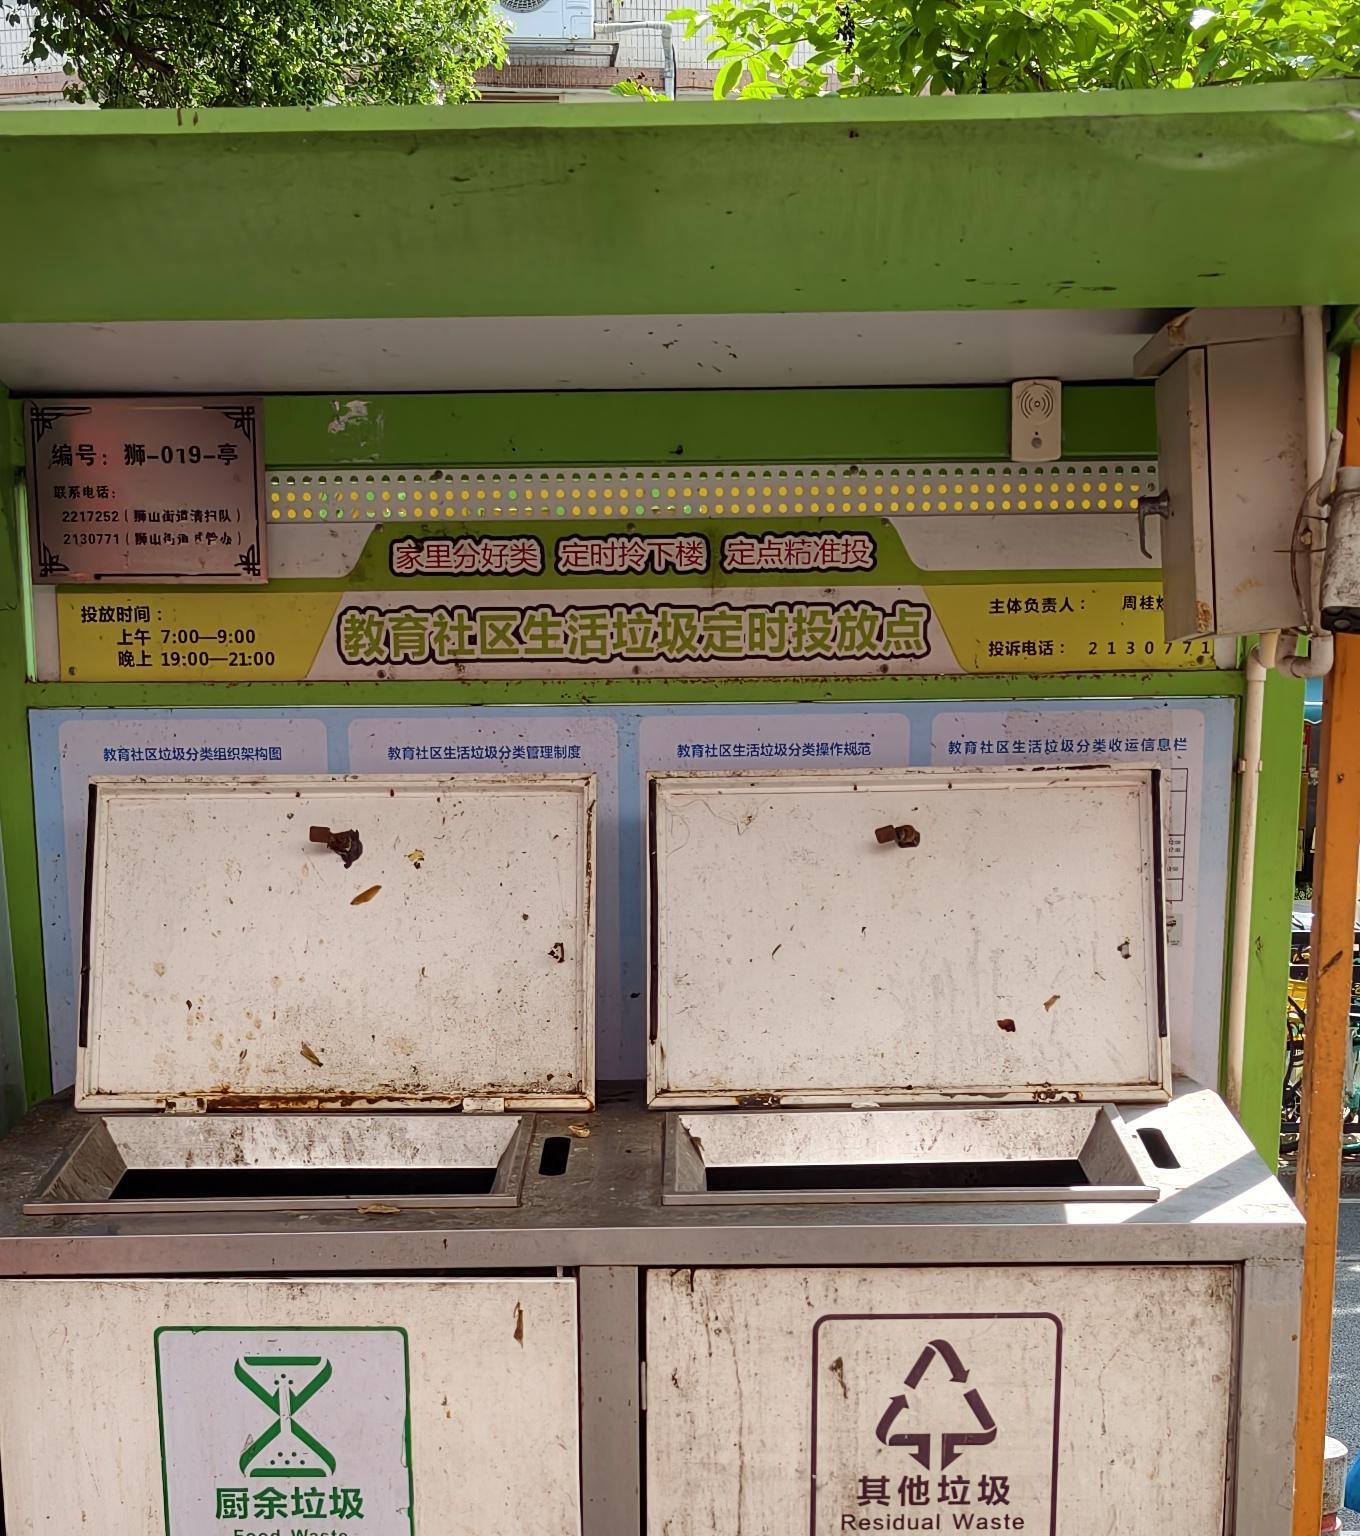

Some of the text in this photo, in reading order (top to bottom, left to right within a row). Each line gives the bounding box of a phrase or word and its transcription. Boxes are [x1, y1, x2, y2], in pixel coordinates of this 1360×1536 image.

[53, 485, 117, 500] 联系电话：
[394, 537, 874, 572] 家里分好类 定时拎下楼 定点精准投
[81, 605, 162, 624] 投放时间：
[989, 596, 1086, 615] 主体负责人：
[117, 629, 151, 646] 上午
[343, 605, 928, 660] 教育社区生活垃圾定时投放点
[989, 639, 1210, 657] 投诉电话： 2130771
[118, 651, 152, 668] 晚上
[103, 746, 282, 762] 教育社区垃圾分类组织架构图
[387, 744, 582, 761] 教育社区生活垃圾分类管理制度
[677, 742, 871, 758] 教育社区生活垃圾分类操作规范
[948, 737, 1188, 755] 教育社区生活垃圾分类收运信息栏
[857, 1475, 1010, 1507] 其他垃圾
[215, 1486, 365, 1520] 厨余垃圾
[841, 1513, 1025, 1531] Residual Waste
